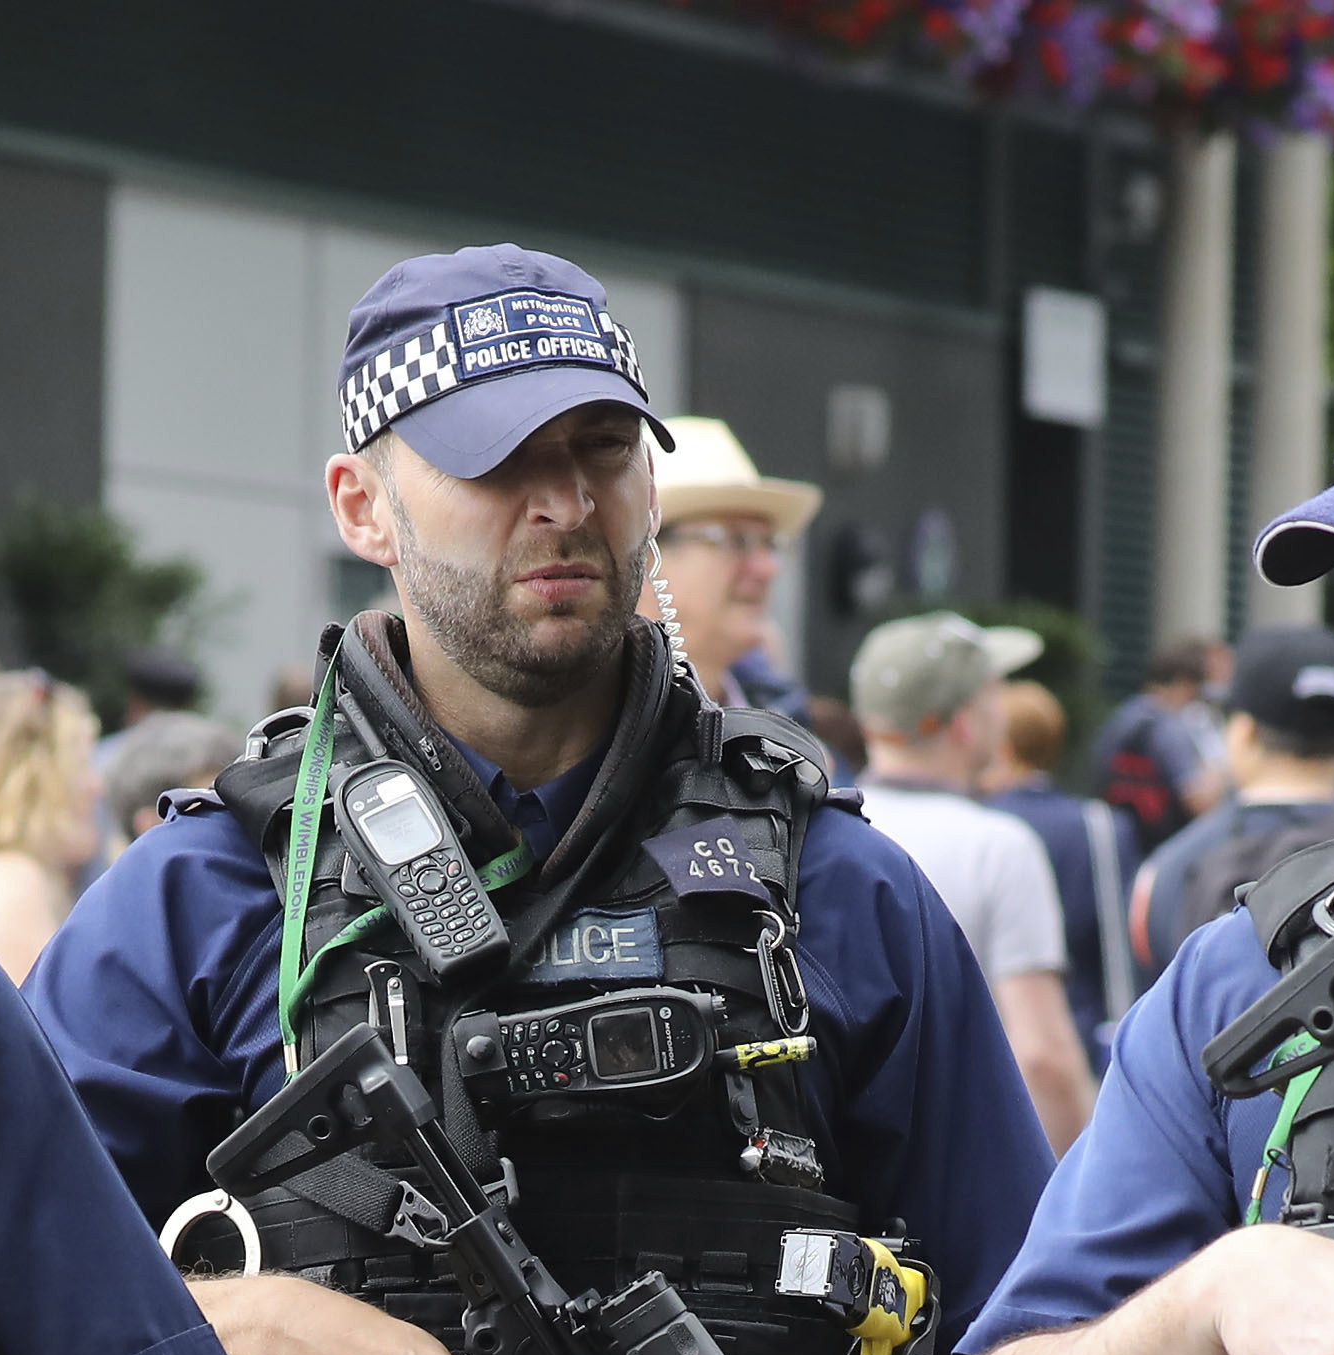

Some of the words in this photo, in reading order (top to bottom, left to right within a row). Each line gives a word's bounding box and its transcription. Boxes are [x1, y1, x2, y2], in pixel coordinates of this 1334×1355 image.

[511, 299, 586, 317] METROPOLITAN
[525, 313, 582, 328] POLICE
[464, 339, 533, 371] POLICE
[536, 336, 608, 360] OFFICER
[693, 837, 736, 858] CO
[288, 810, 315, 921] WIMBLEDON
[688, 857, 761, 884] 4672
[532, 924, 640, 967] LICE
[664, 1022, 676, 1068] MOTOROLA
